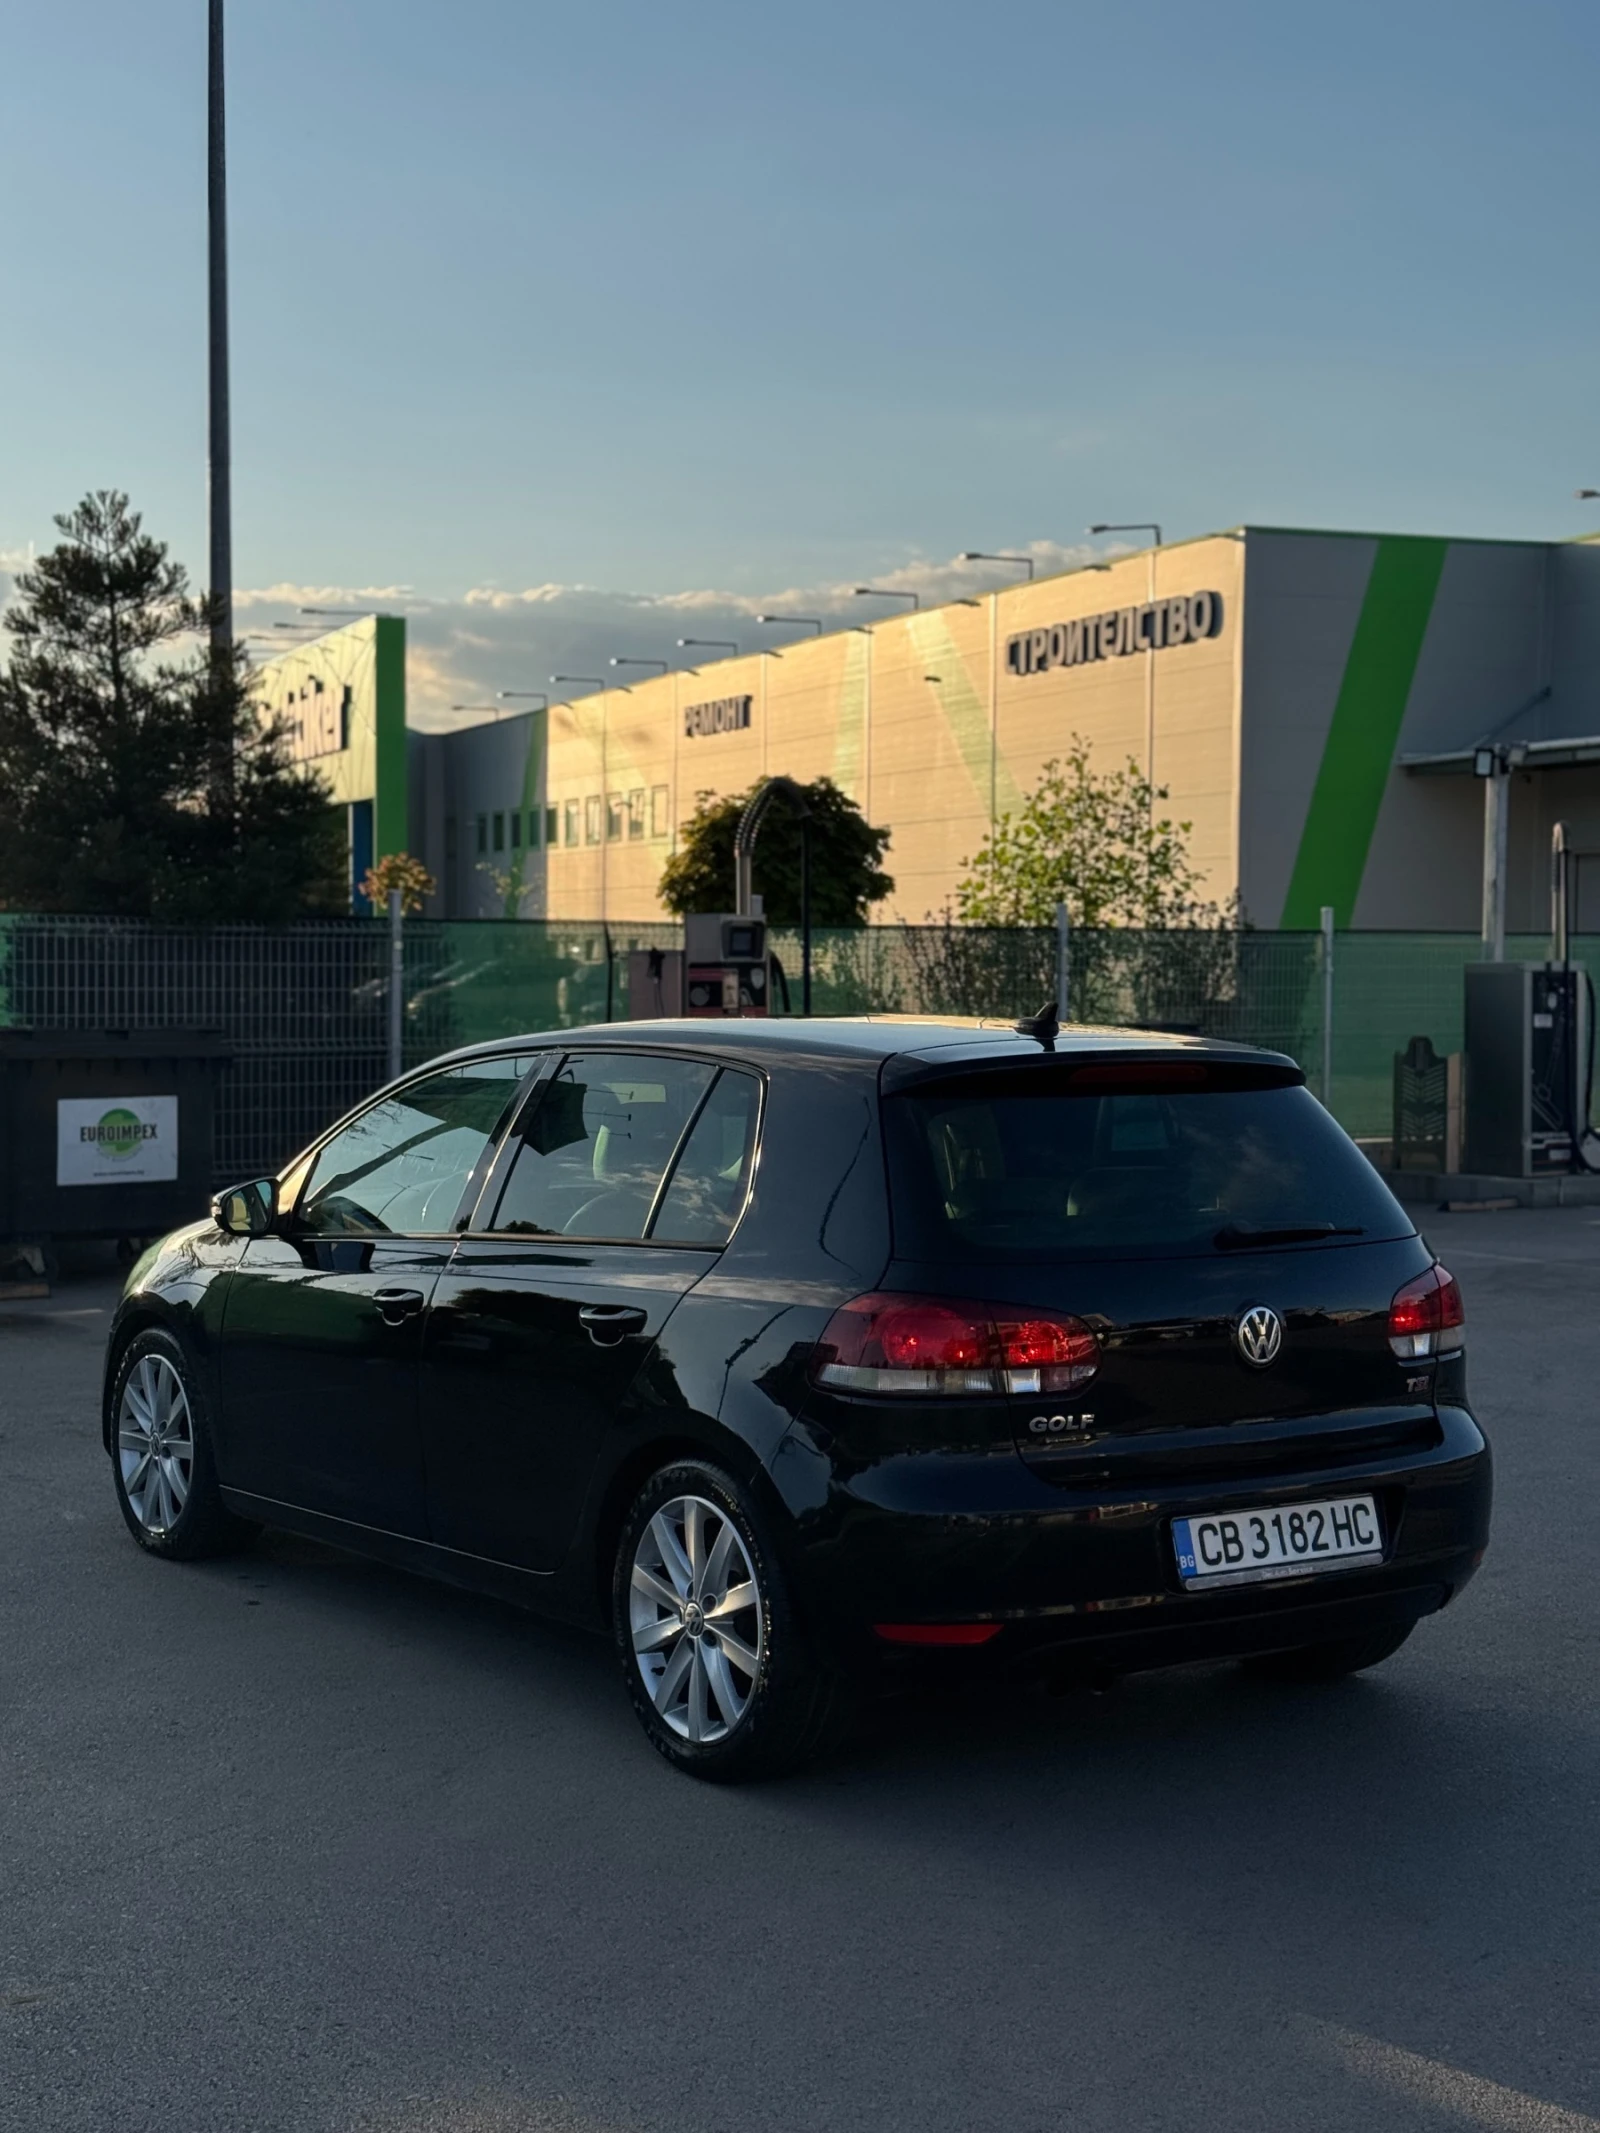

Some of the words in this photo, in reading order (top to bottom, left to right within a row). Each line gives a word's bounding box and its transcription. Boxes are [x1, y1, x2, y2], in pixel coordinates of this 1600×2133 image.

[1006, 590, 1223, 675] СТРОИТЕЛСТВО
[684, 694, 752, 738] РЕМОНТ
[80, 1123, 158, 1142] EUROIMPEX
[1238, 1306, 1281, 1363] VW
[1029, 1413, 1095, 1433] GOLF
[1179, 1555, 1195, 1569] BG
